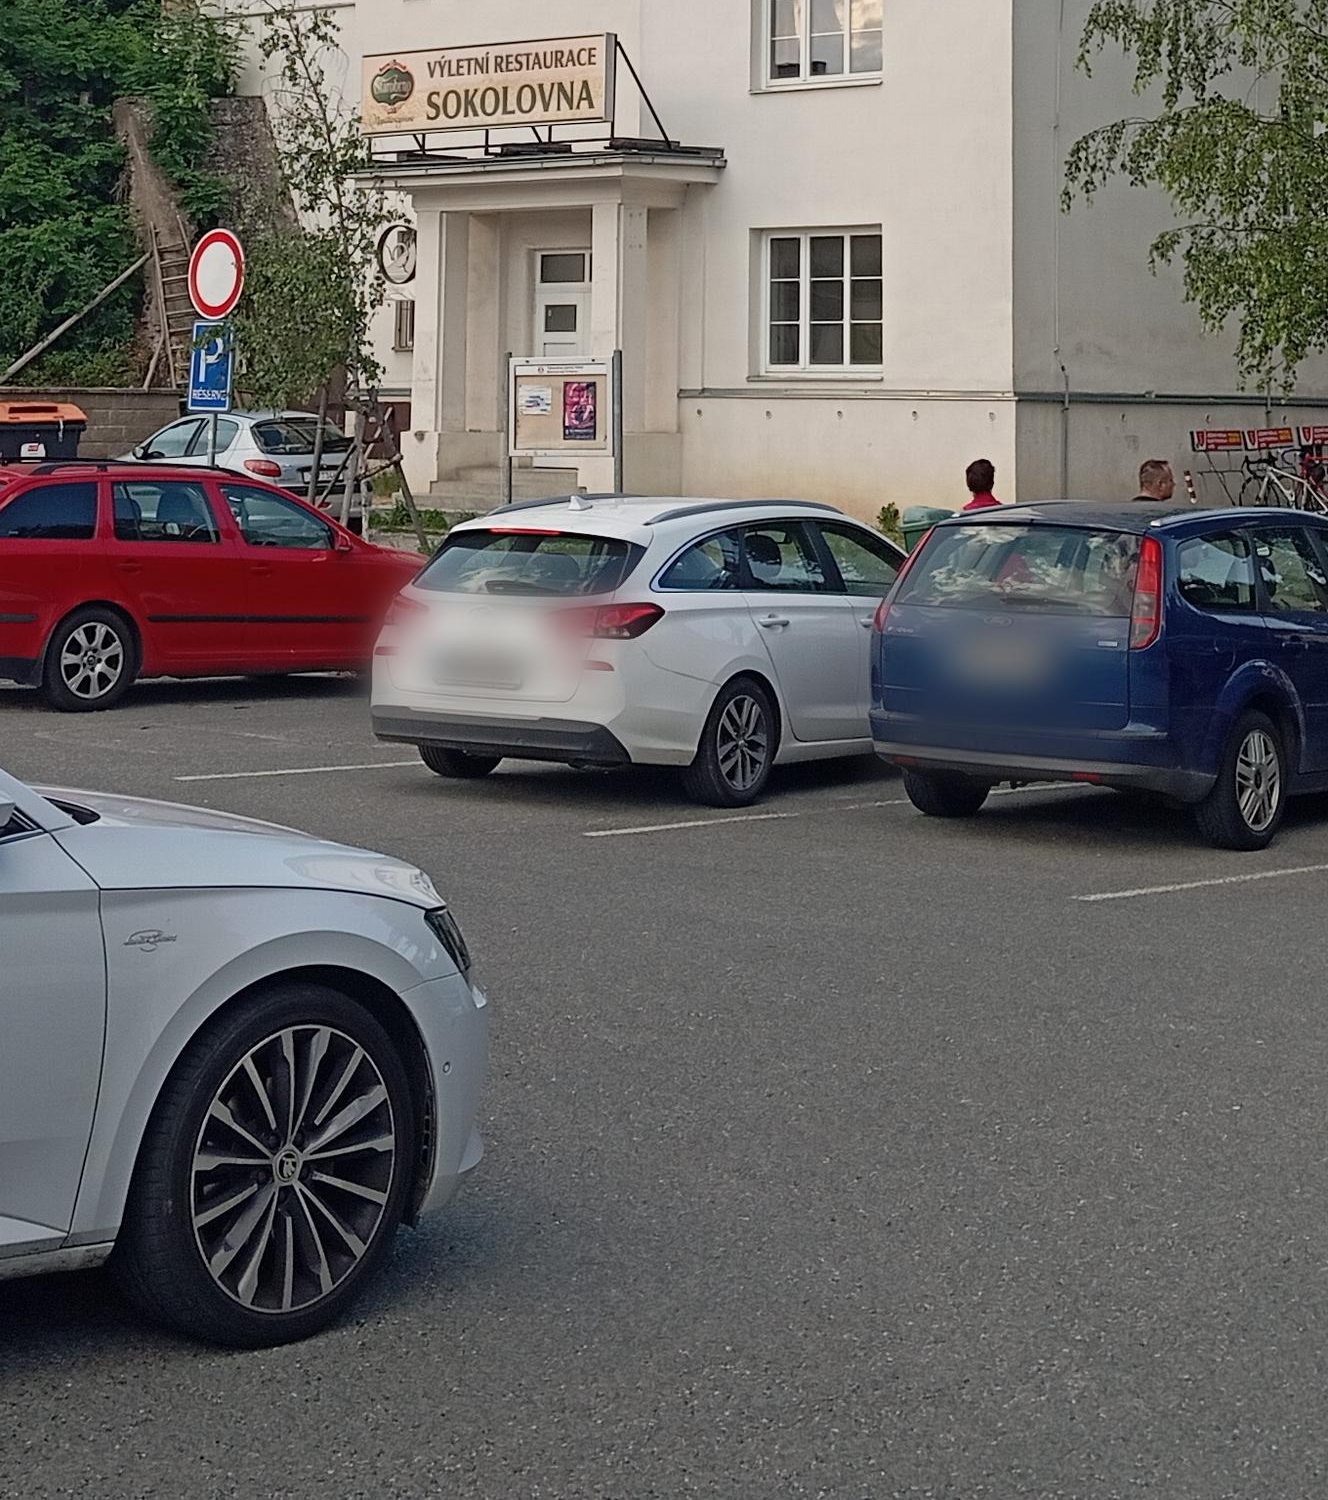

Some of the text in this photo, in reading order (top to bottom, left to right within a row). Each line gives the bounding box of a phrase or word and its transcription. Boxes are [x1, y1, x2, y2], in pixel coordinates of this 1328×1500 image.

[426, 47, 597, 79] VÝLETNÍ RESTAURACE
[425, 79, 595, 121] SOKOLOVNA
[198, 336, 224, 383] P
